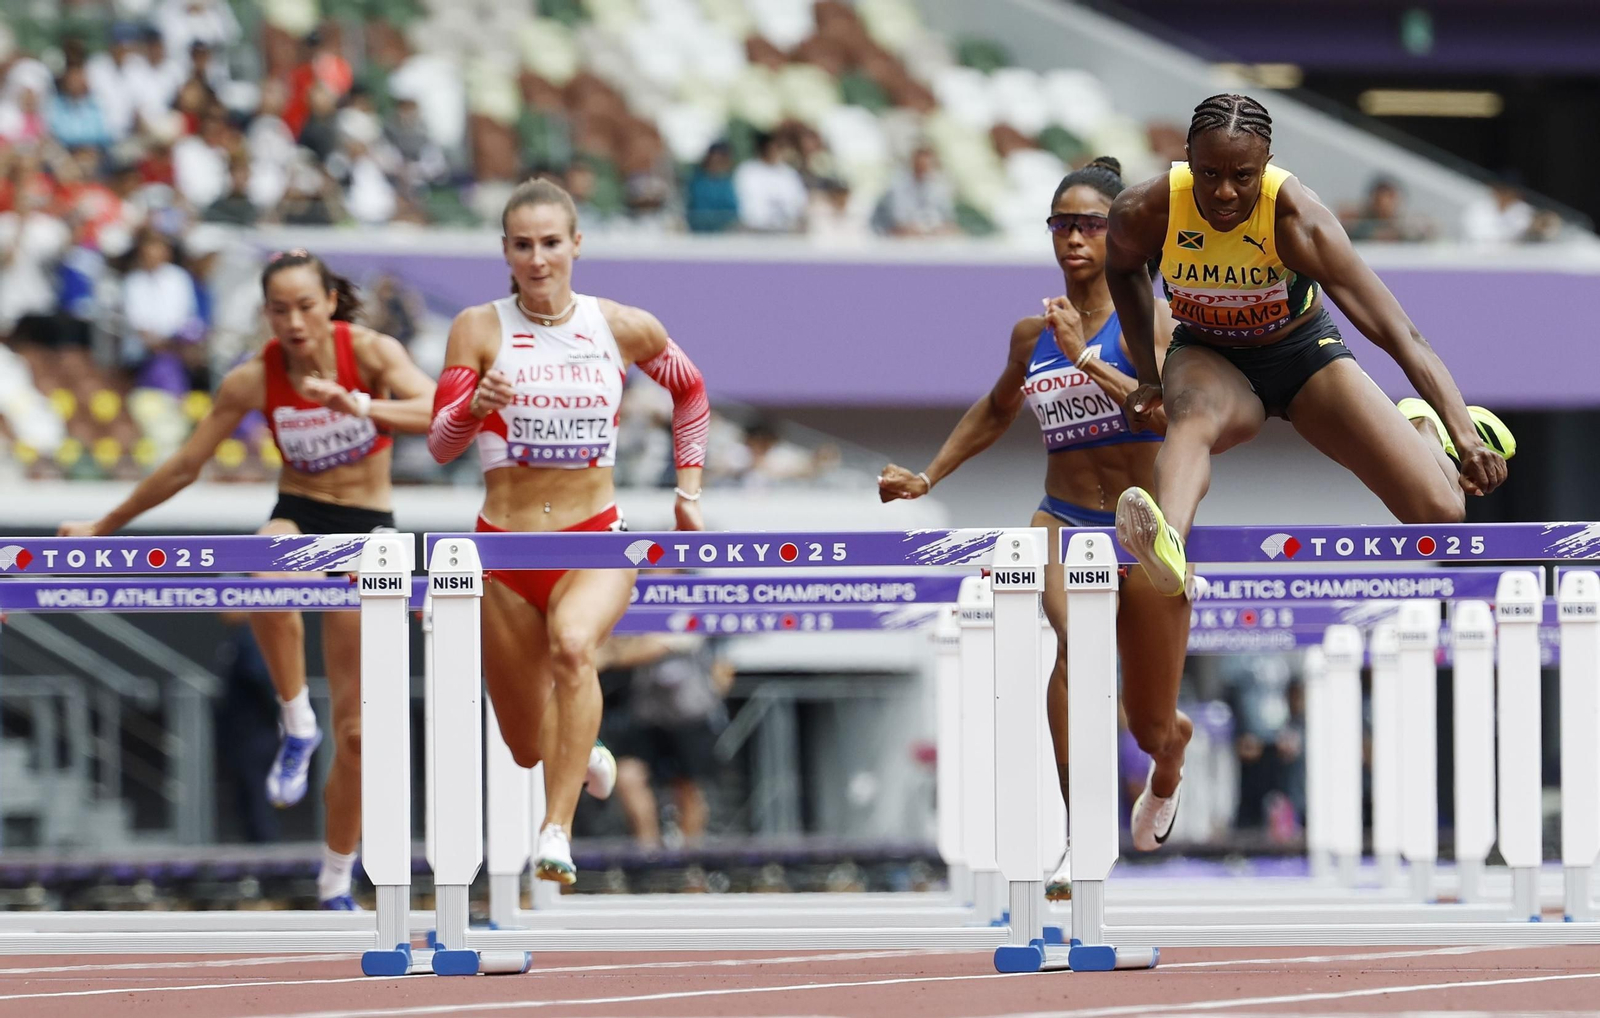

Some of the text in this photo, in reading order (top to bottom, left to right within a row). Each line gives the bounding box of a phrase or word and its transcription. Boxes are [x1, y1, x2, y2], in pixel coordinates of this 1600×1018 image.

[1172, 263, 1280, 285] JAMAICA
[515, 364, 605, 385] AUSTRIA
[511, 393, 609, 409] HONDA
[512, 417, 608, 440] STRAMETZ
[362, 577, 402, 590] NISHI
[433, 577, 473, 589] NISHI
[995, 571, 1036, 585] NISHI
[1069, 571, 1110, 584] NISHI
[1290, 577, 1455, 598] CHAMPIONSHIPS
[36, 586, 361, 607] WORLD ATHLETICS CHAMPIONSHI
[643, 584, 749, 604] ATHLETICS
[752, 582, 917, 603] CHAMPIONSHIPS
